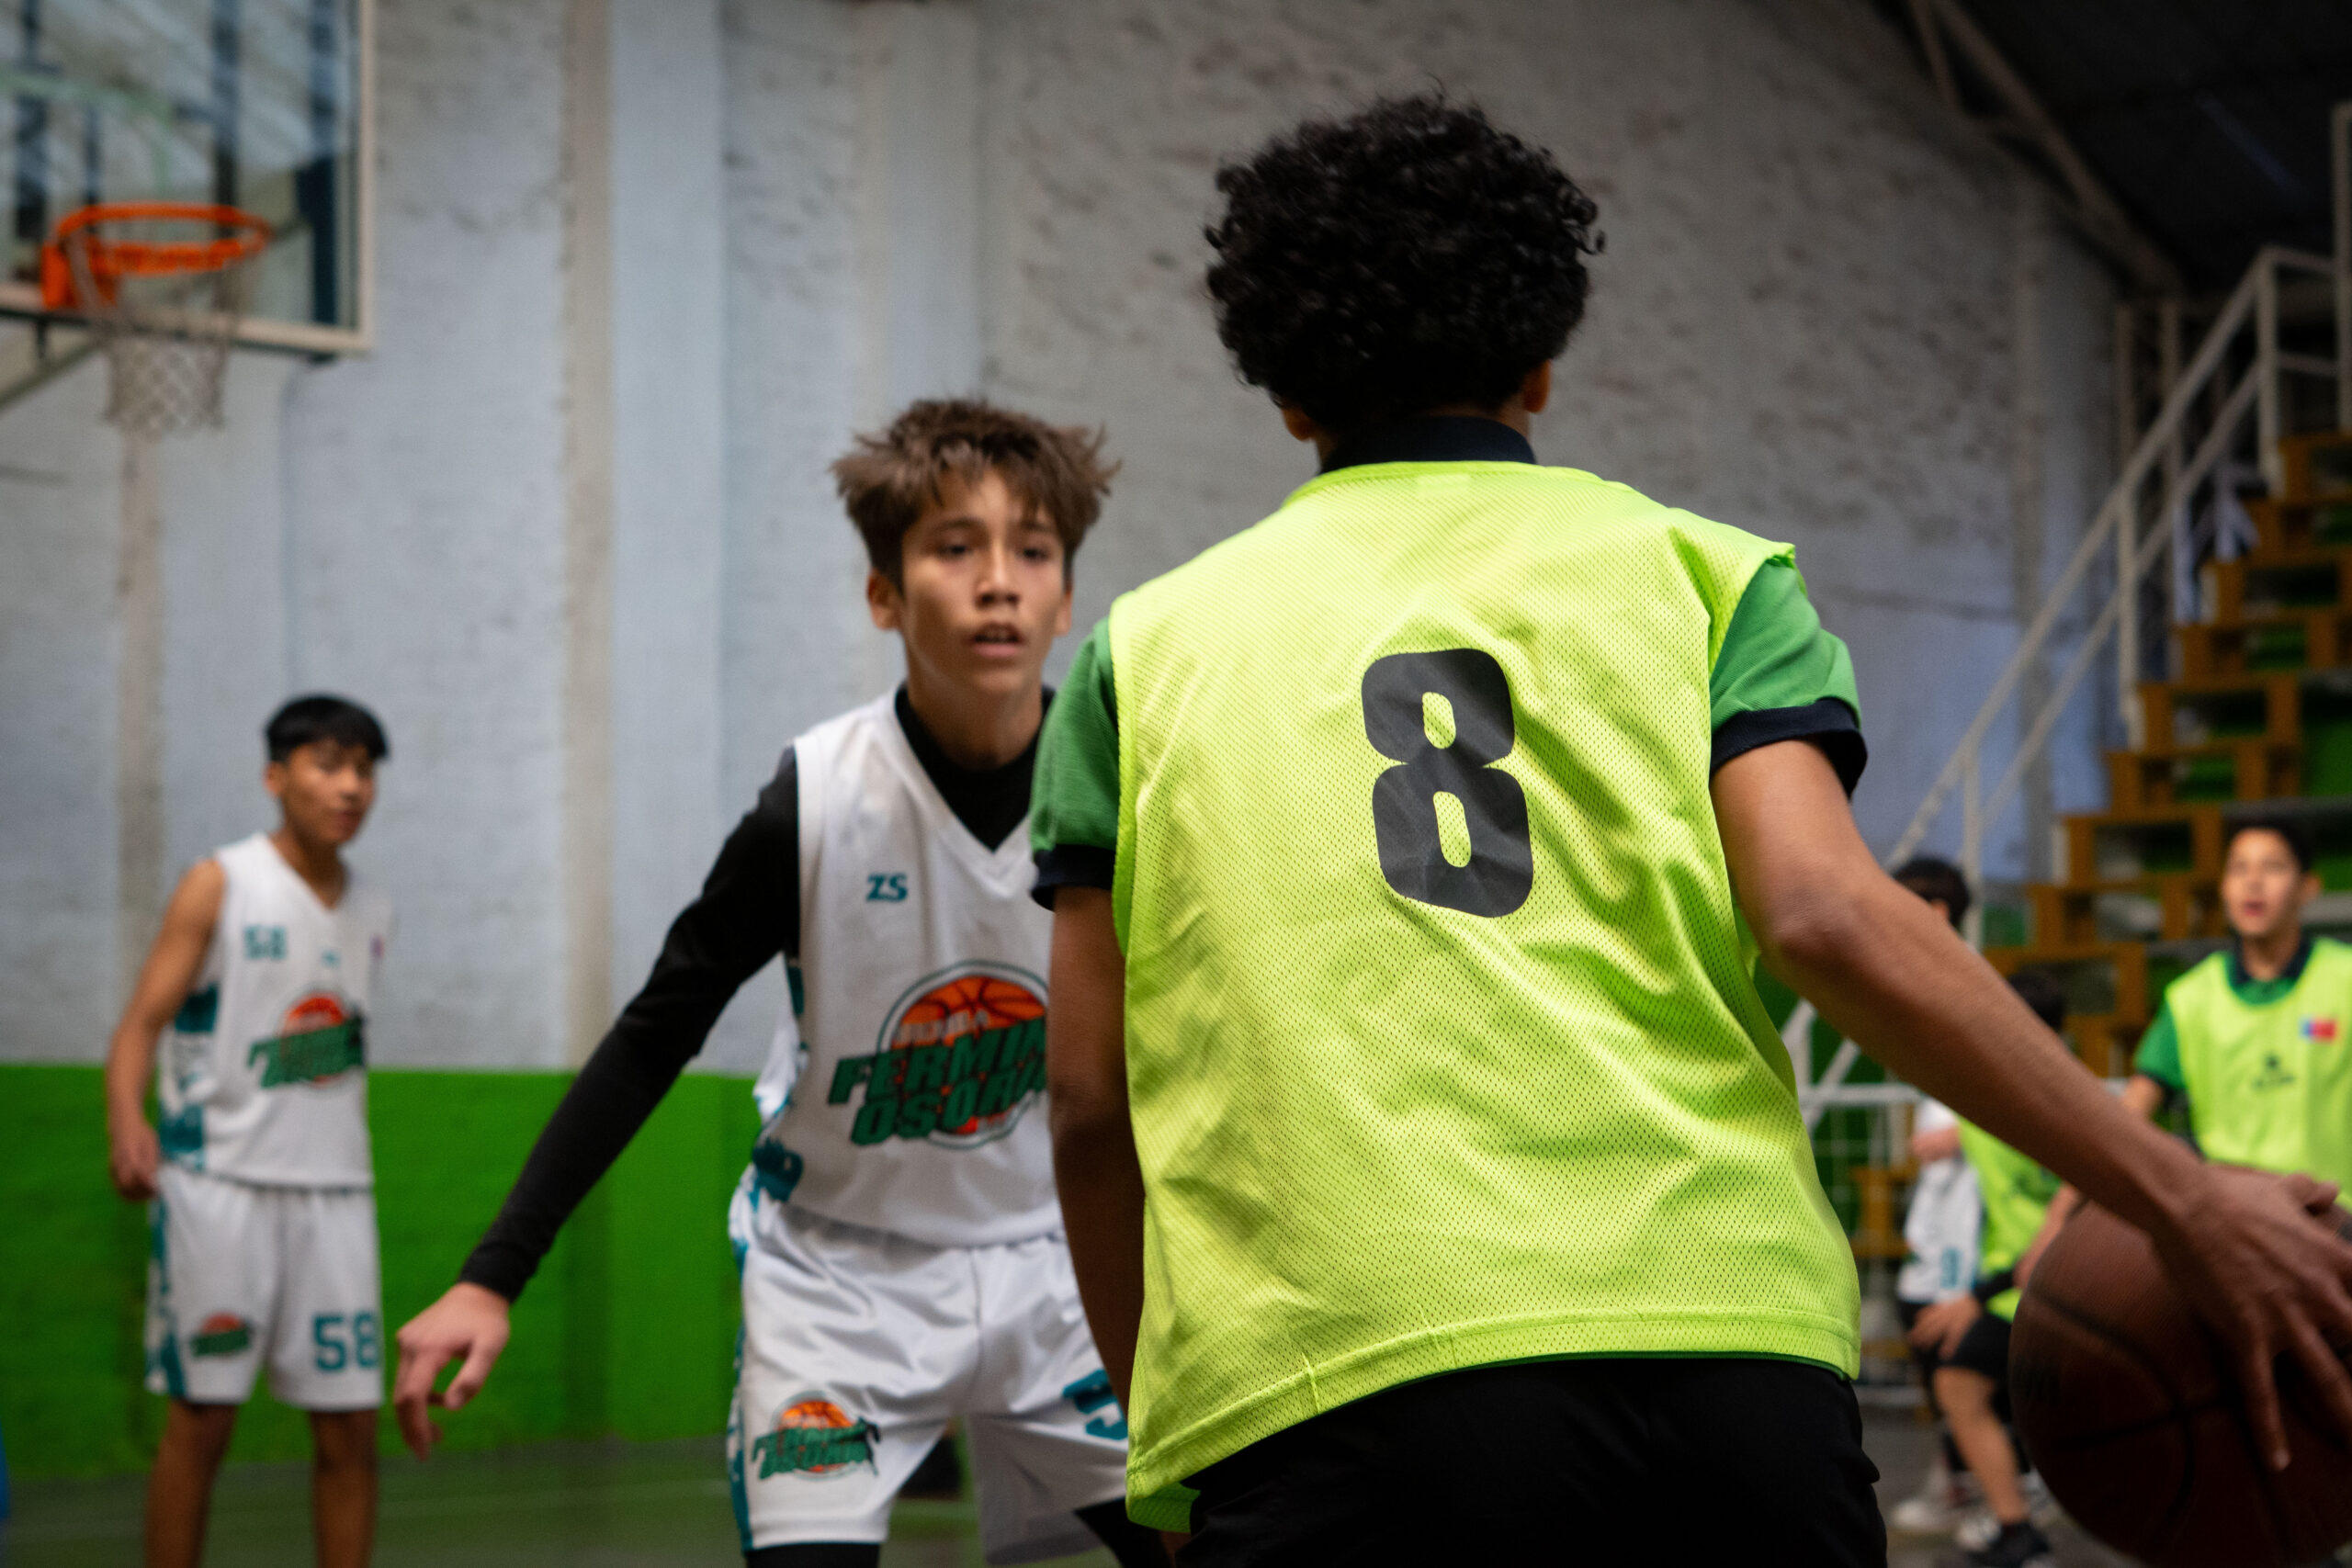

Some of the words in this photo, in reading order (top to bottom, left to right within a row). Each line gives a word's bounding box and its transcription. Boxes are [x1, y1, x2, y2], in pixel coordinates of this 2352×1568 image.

[1361, 648, 1533, 918] 8
[866, 873, 908, 902] ZS
[311, 1307, 379, 1372] 58
